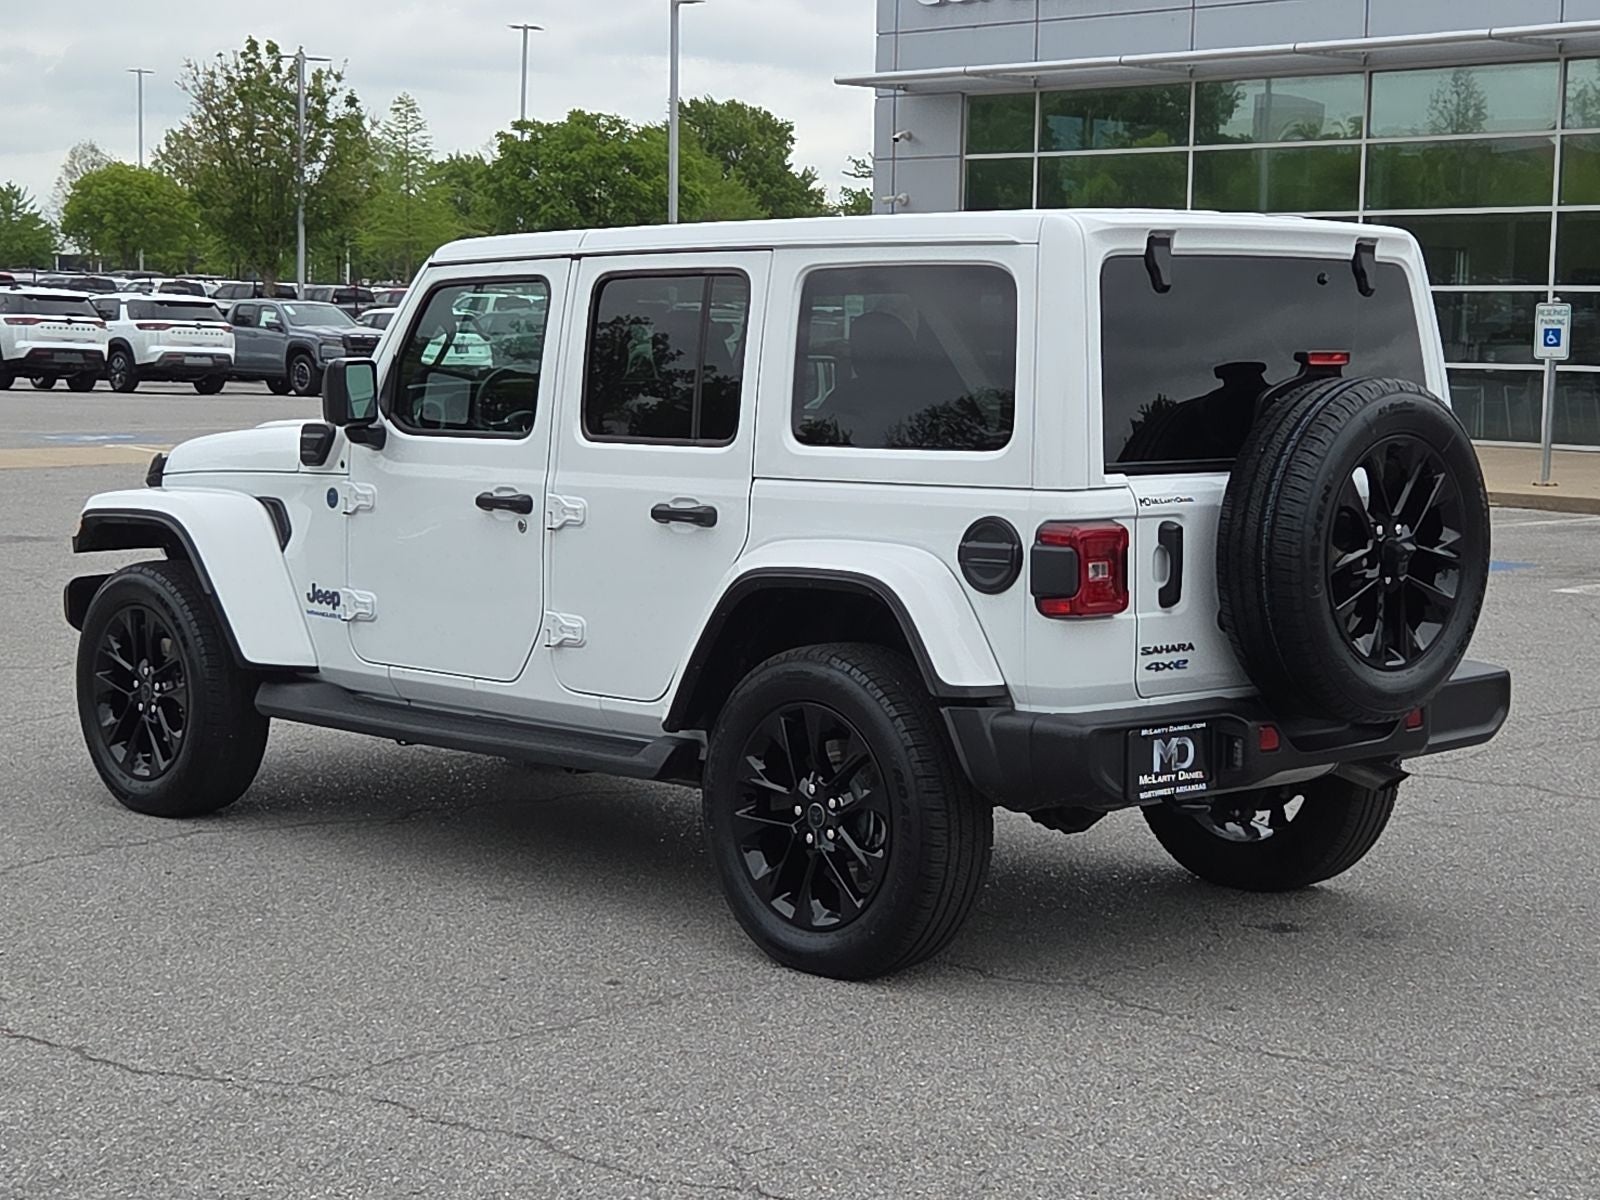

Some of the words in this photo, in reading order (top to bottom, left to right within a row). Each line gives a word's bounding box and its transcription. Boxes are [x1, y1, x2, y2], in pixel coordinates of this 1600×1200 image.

[1540, 318, 1566, 326] PARKING
[306, 582, 341, 611] Jeep
[1140, 641, 1195, 656] SAHARA
[1153, 737, 1195, 772] MD
